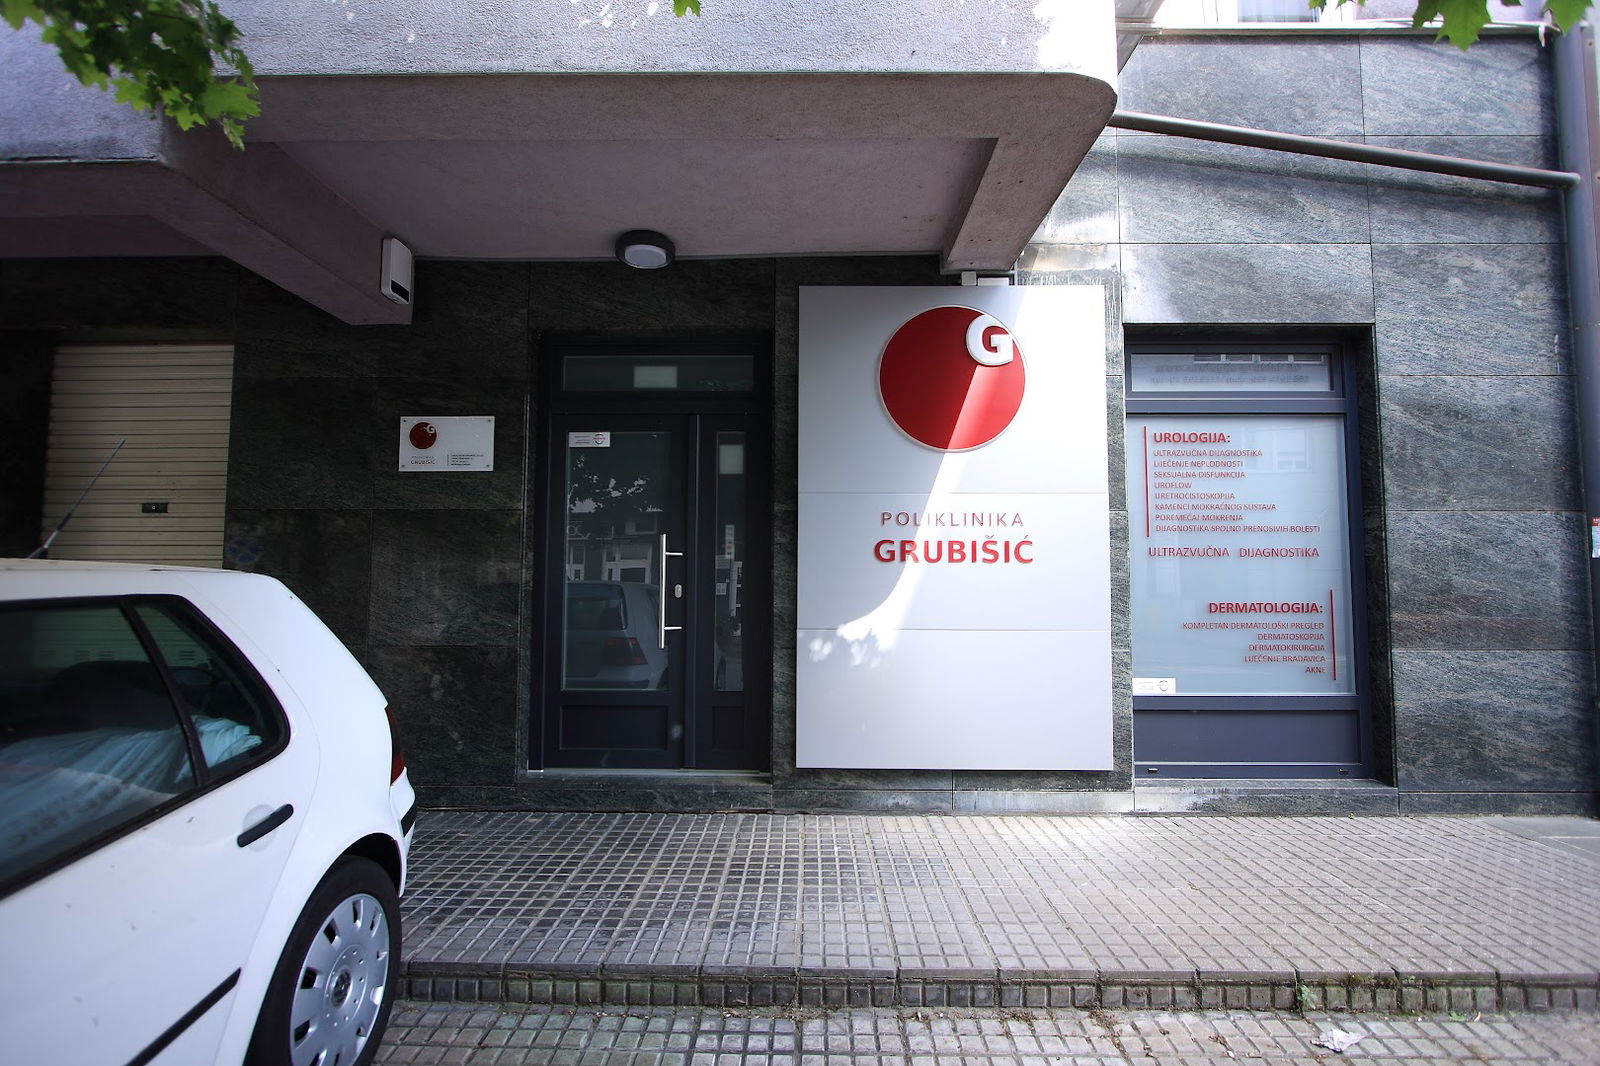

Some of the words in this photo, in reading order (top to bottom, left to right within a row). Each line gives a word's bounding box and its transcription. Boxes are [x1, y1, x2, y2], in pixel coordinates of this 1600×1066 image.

[965, 314, 1014, 366] G
[1153, 432, 1230, 443] UROLOGIJA:
[1153, 448, 1207, 457] ULTRAZVUČNA
[1154, 459, 1189, 467] LIJEČENJE
[1192, 502, 1242, 510] MOKRAĆNOG
[881, 511, 1024, 526] POLIKLINIKA
[874, 535, 1033, 564] GRUBIŠIĆ
[1149, 545, 1229, 557] ULTRAZVUČNA
[1239, 548, 1319, 558] DIJAGNOSTIKA
[1209, 602, 1323, 613] DERMATOLOGIJA:
[1230, 621, 1288, 629] DERMATOLOŠKI
[1245, 654, 1280, 663] LIJEČENJE
